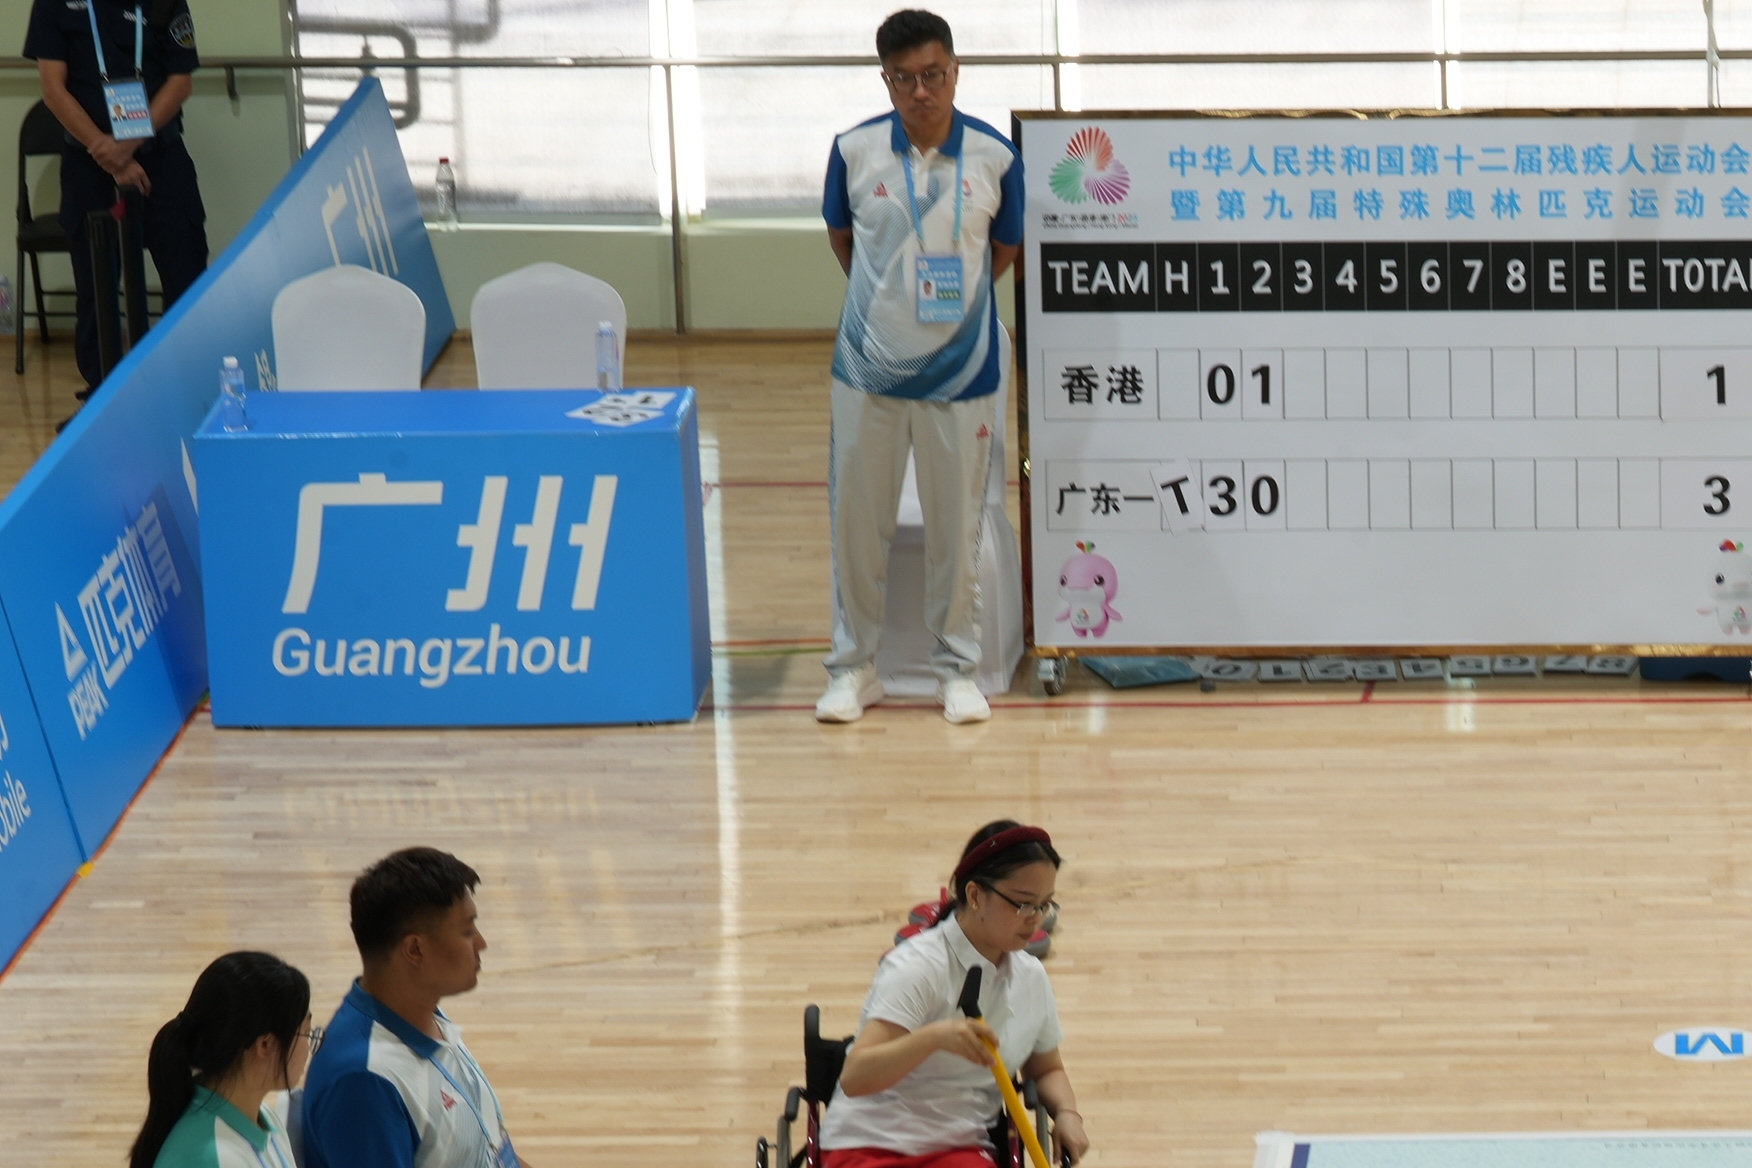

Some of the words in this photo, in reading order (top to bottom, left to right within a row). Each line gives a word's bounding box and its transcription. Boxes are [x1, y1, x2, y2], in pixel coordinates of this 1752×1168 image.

[1168, 144, 1751, 179] 中华人民共和国第十二届残疾人运动会
[1169, 187, 1751, 221] 暨第九届特殊奥林匹克运动会
[1047, 260, 1151, 296] TEAM
[1164, 260, 1191, 295] H
[1210, 260, 1230, 295] 1
[1250, 260, 1274, 295] 2
[1292, 260, 1314, 294] 3
[1334, 260, 1359, 294] 4
[1378, 260, 1400, 294] 5
[1419, 259, 1443, 294] 6
[1463, 259, 1485, 293] 7
[1504, 259, 1528, 294] 8
[1548, 259, 1567, 293] E
[1587, 259, 1607, 293] E
[1627, 259, 1646, 293] E
[1060, 365, 1145, 407] 香港
[1206, 363, 1237, 406] 0
[1250, 364, 1276, 405] 1
[1705, 364, 1730, 406] 1
[1056, 482, 1155, 516] 广东一
[1209, 475, 1238, 516] 3
[1251, 475, 1280, 516] 0
[1702, 475, 1732, 516] 3
[281, 472, 618, 614] 广州
[271, 622, 592, 690] Guangzhou
[67, 658, 110, 742] PEAK
[0, 769, 32, 853] obile
